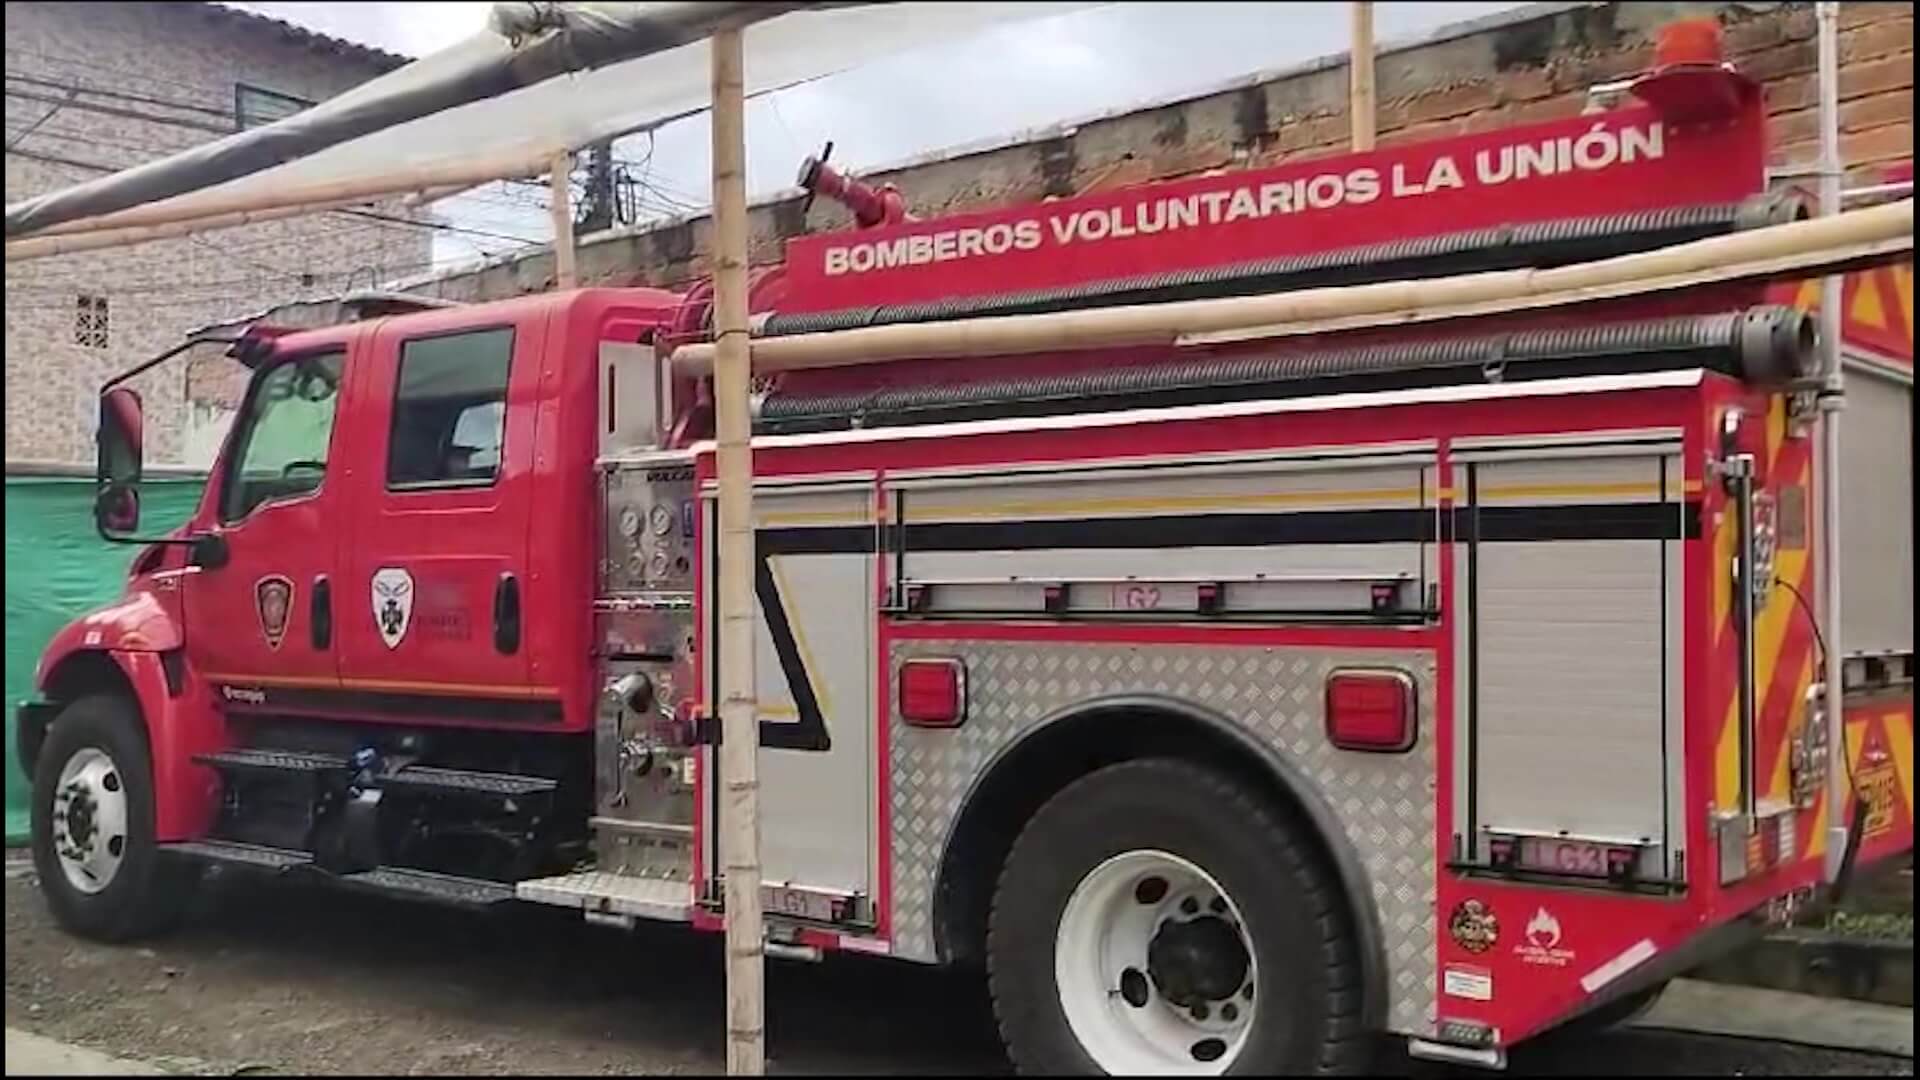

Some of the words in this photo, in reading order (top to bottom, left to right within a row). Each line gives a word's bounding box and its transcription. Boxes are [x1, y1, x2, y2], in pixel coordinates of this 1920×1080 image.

[824, 219, 1042, 276] BOMBEROS
[1050, 168, 1381, 245] VOLUNTARIOS
[1392, 156, 1464, 197] LA
[1476, 122, 1664, 184] UNIÓN
